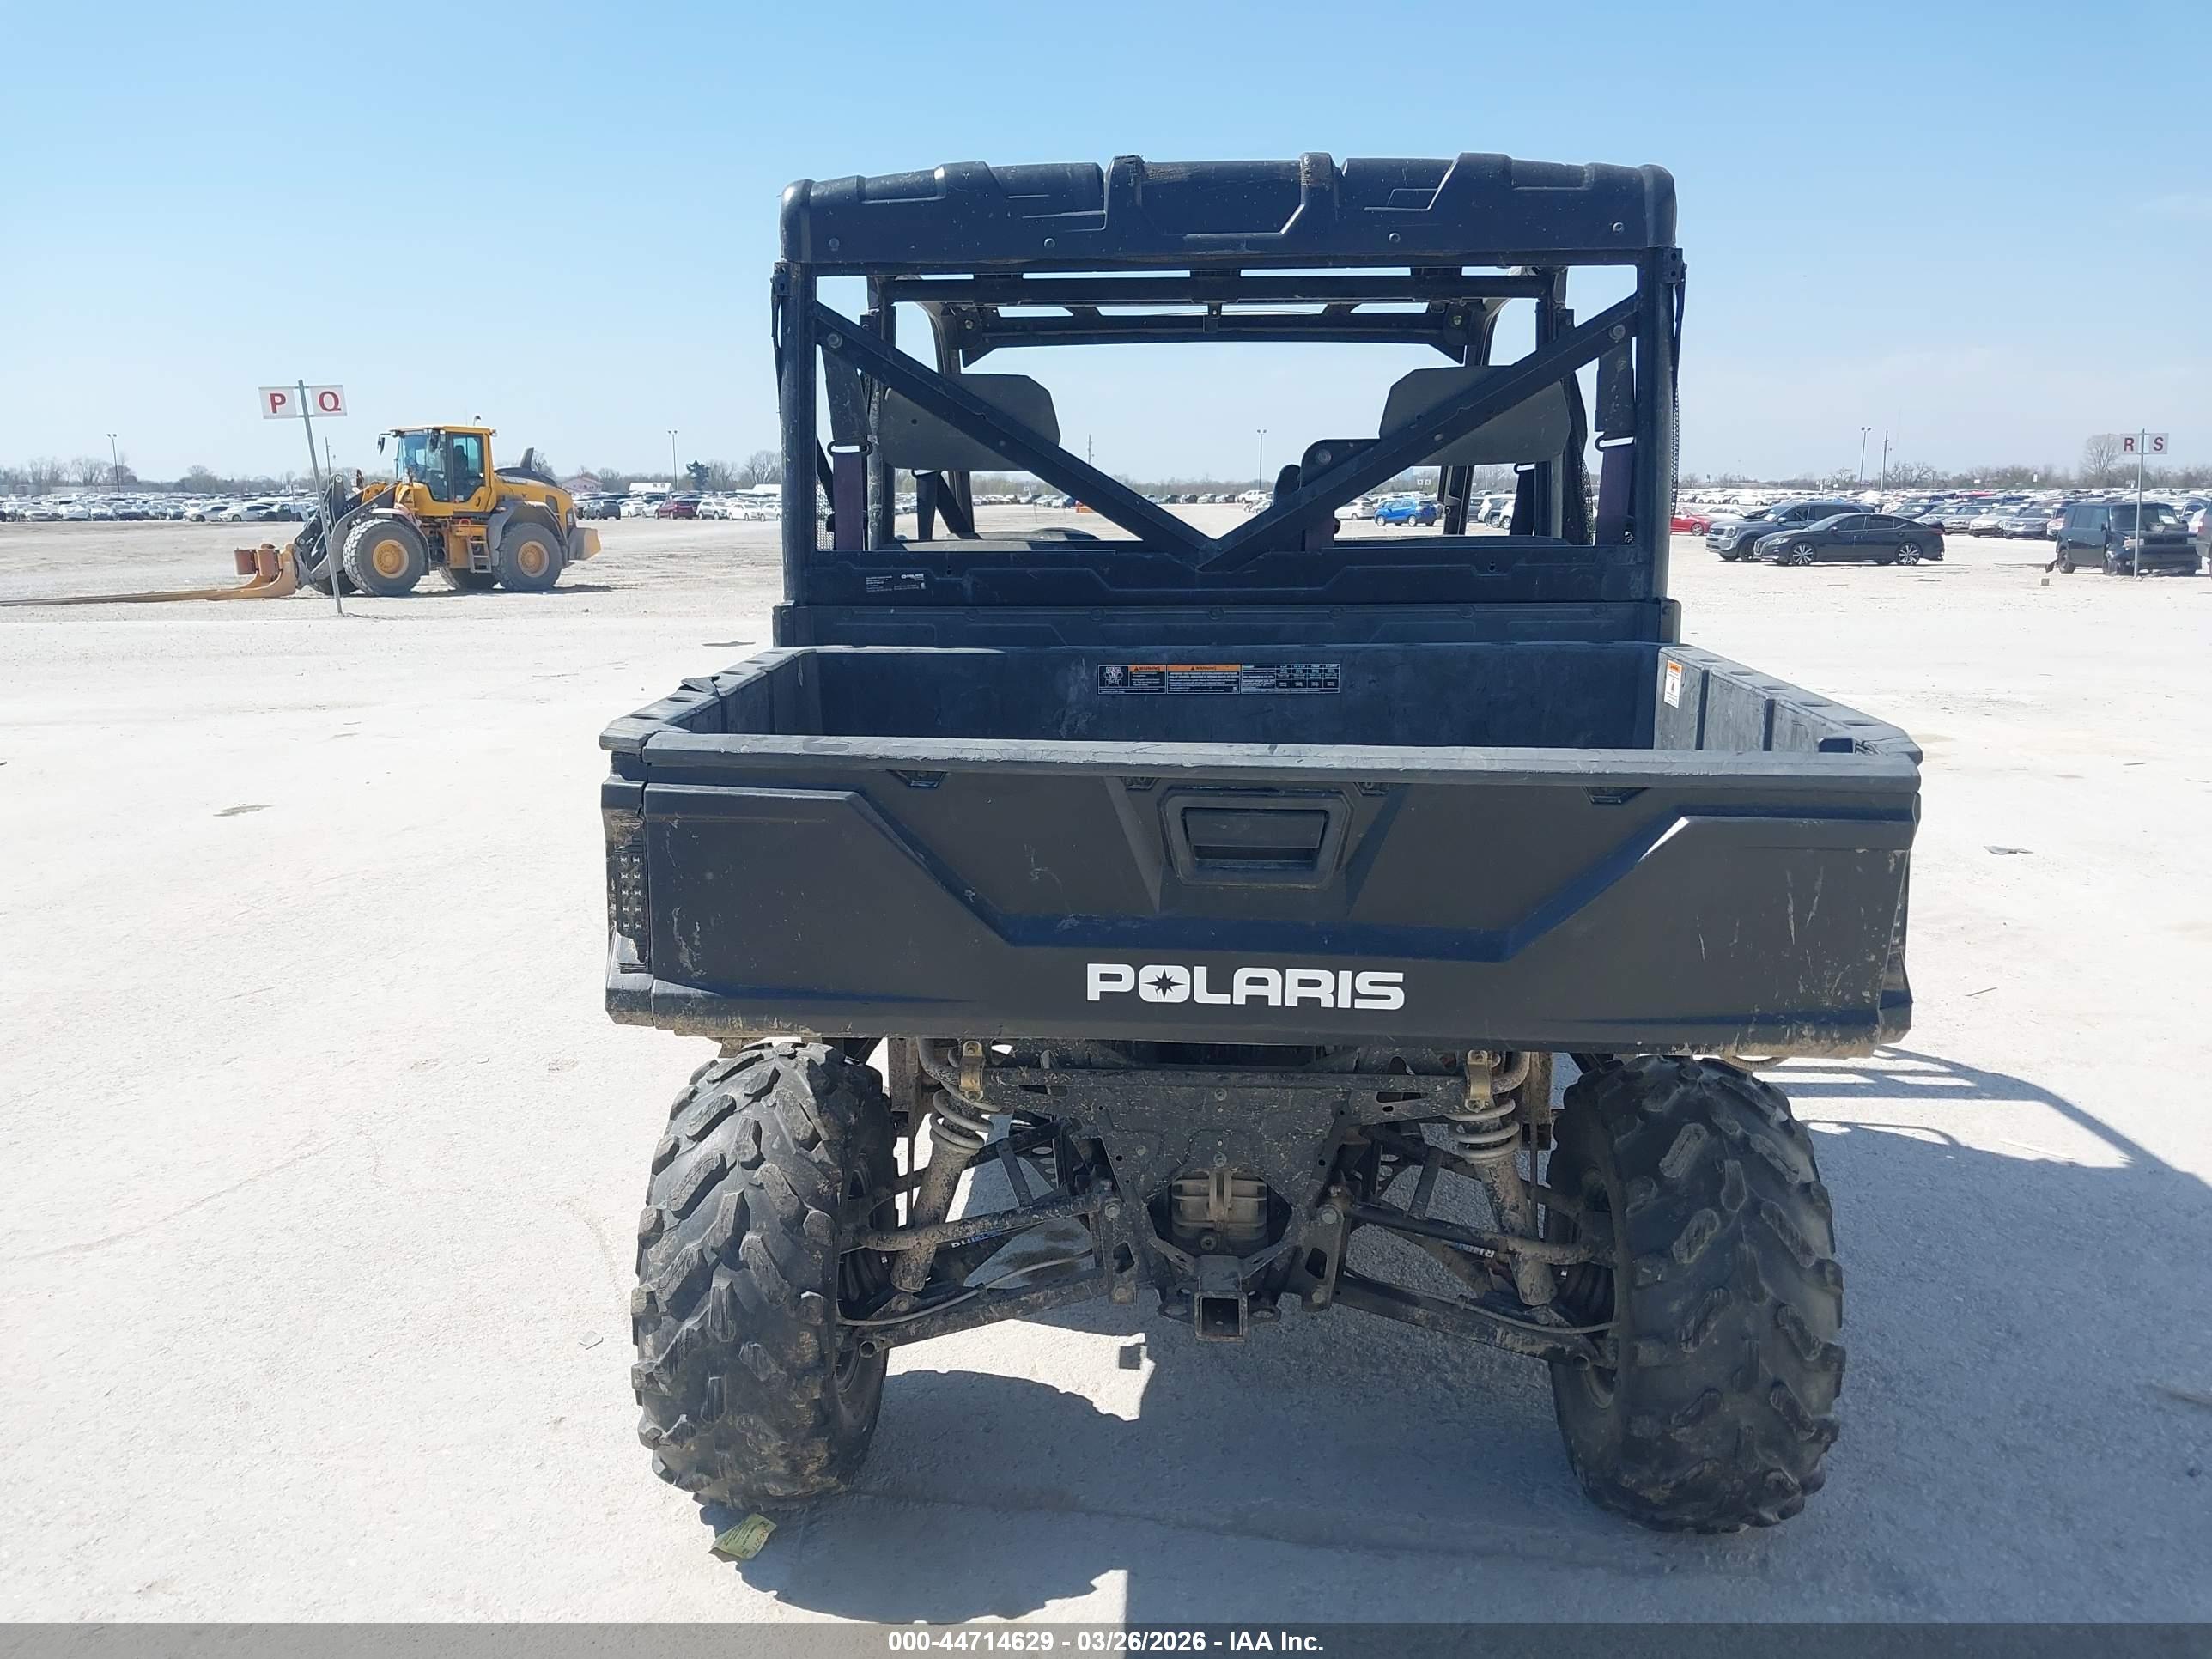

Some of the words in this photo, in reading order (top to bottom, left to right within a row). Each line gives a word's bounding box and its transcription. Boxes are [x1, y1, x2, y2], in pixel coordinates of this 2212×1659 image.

[269, 392, 286, 414] P
[319, 391, 341, 412] Q
[2124, 437, 2135, 452] R
[2153, 436, 2164, 452] S
[1087, 963, 1405, 1010] POLARIS
